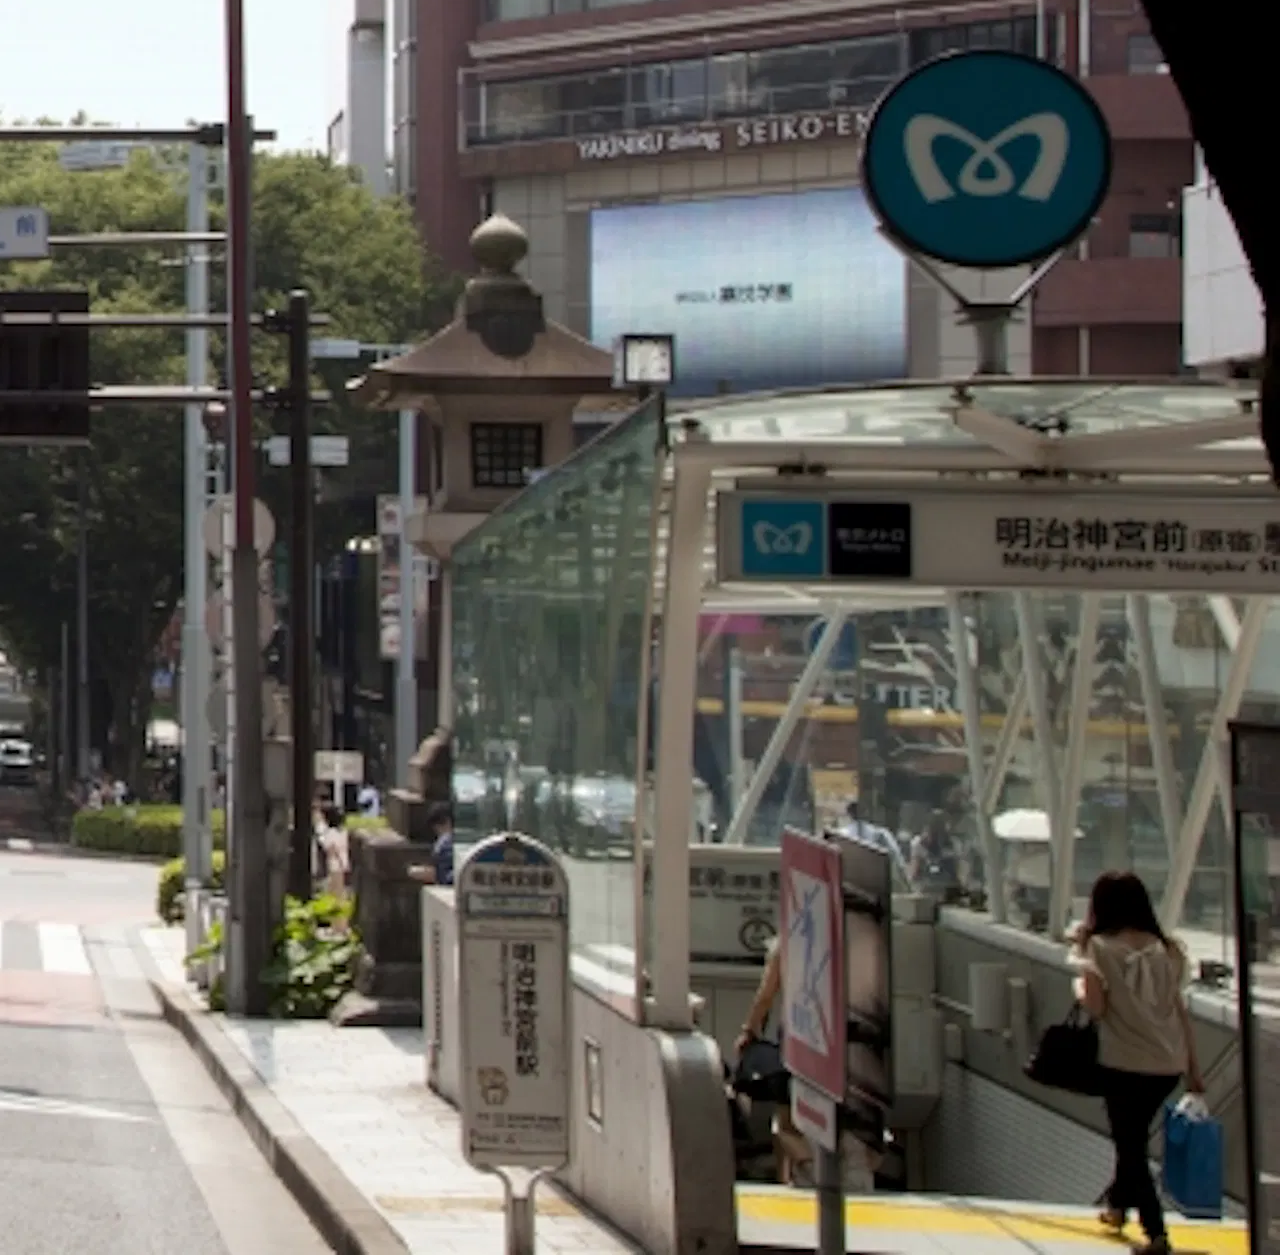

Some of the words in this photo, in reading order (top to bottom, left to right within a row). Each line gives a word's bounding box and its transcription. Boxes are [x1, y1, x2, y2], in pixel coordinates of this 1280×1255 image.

[577, 132, 662, 160] YAKINIKU
[512, 943, 539, 1077] 明治神宮前駅
